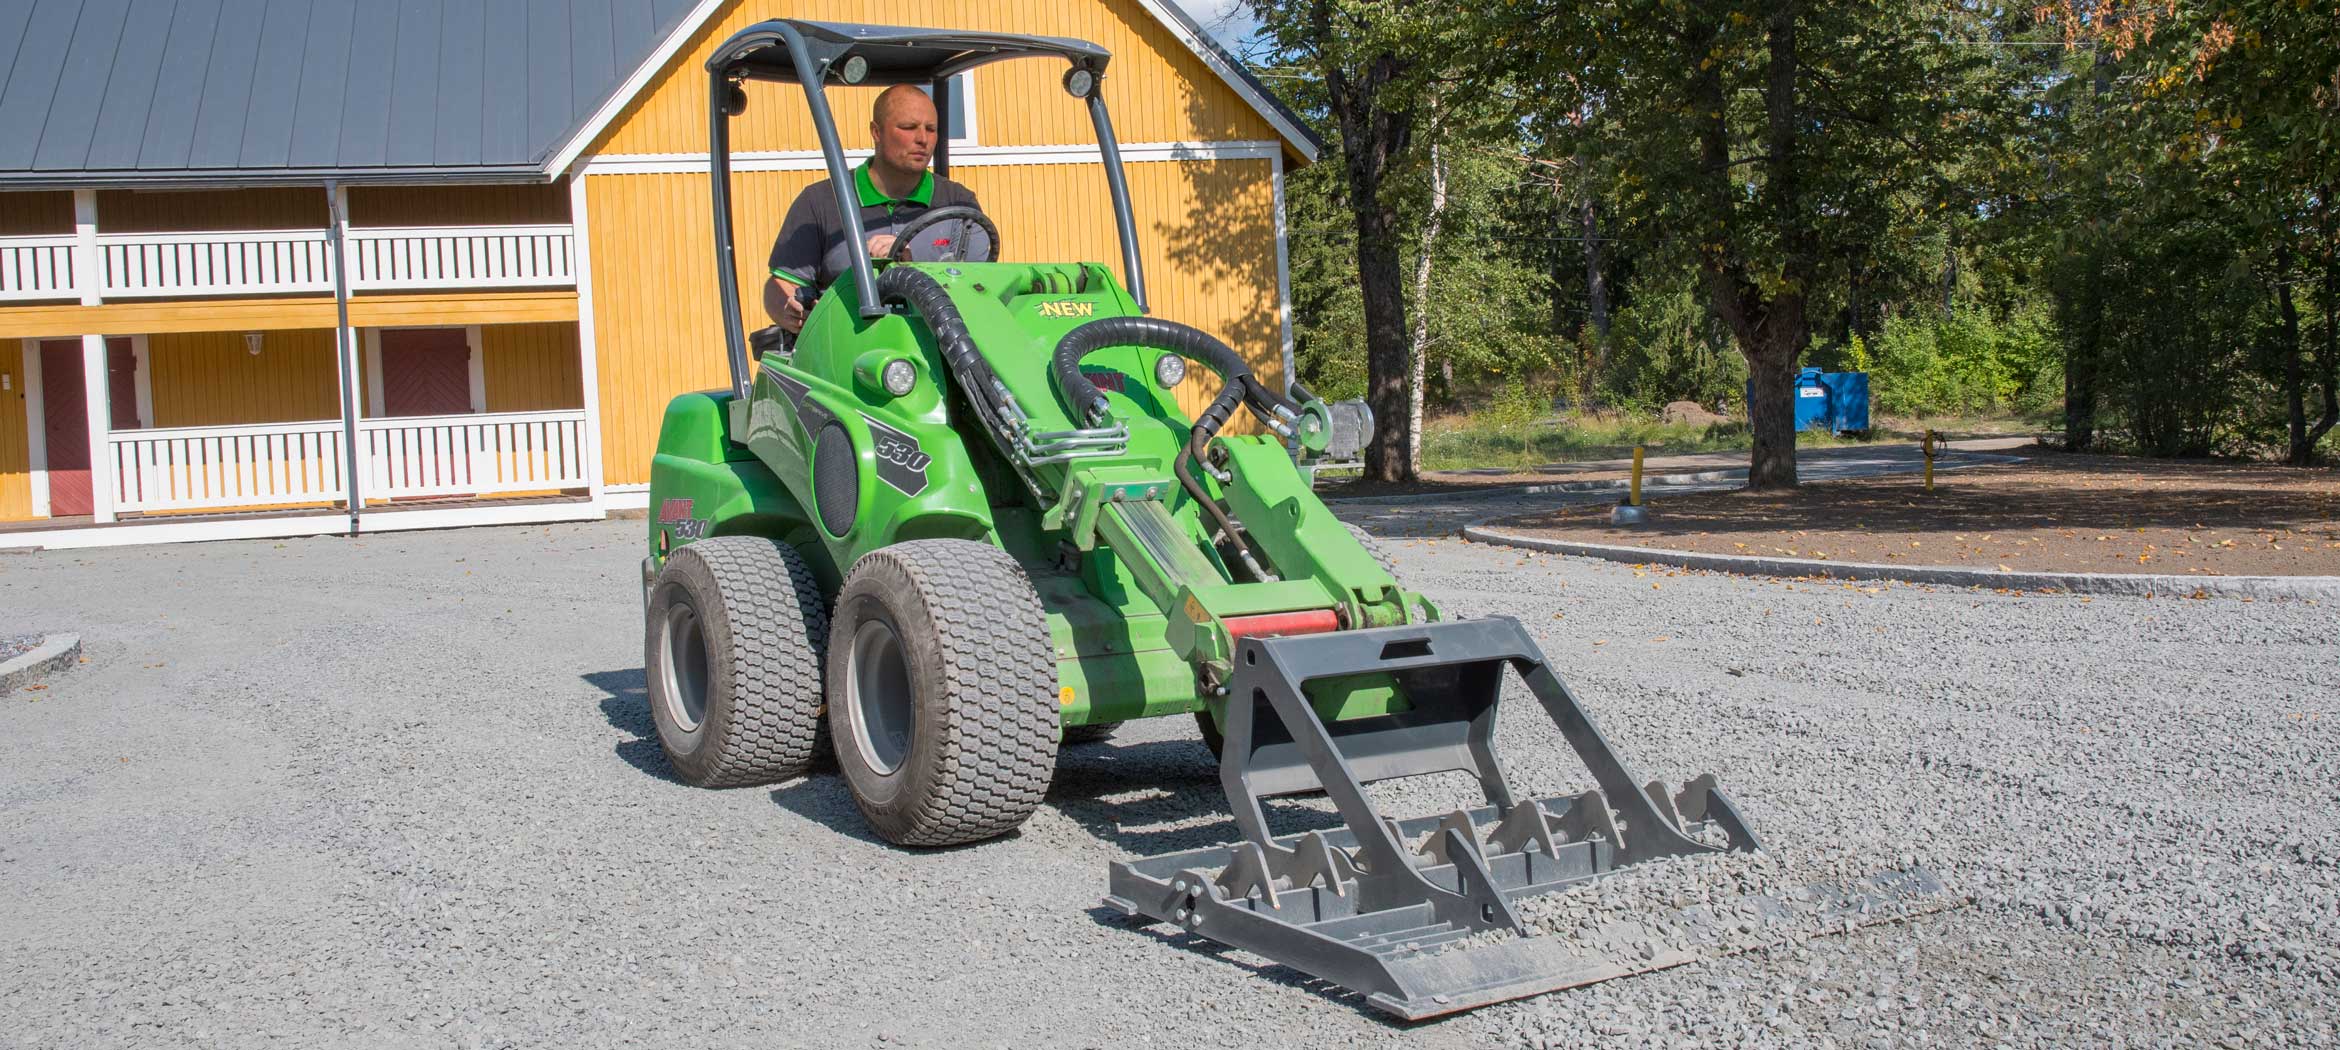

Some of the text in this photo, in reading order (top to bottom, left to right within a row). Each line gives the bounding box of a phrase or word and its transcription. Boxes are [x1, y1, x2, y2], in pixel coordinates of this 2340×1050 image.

[1041, 301, 1094, 318] NEW
[875, 436, 932, 472] 530
[675, 518, 709, 540] 530
